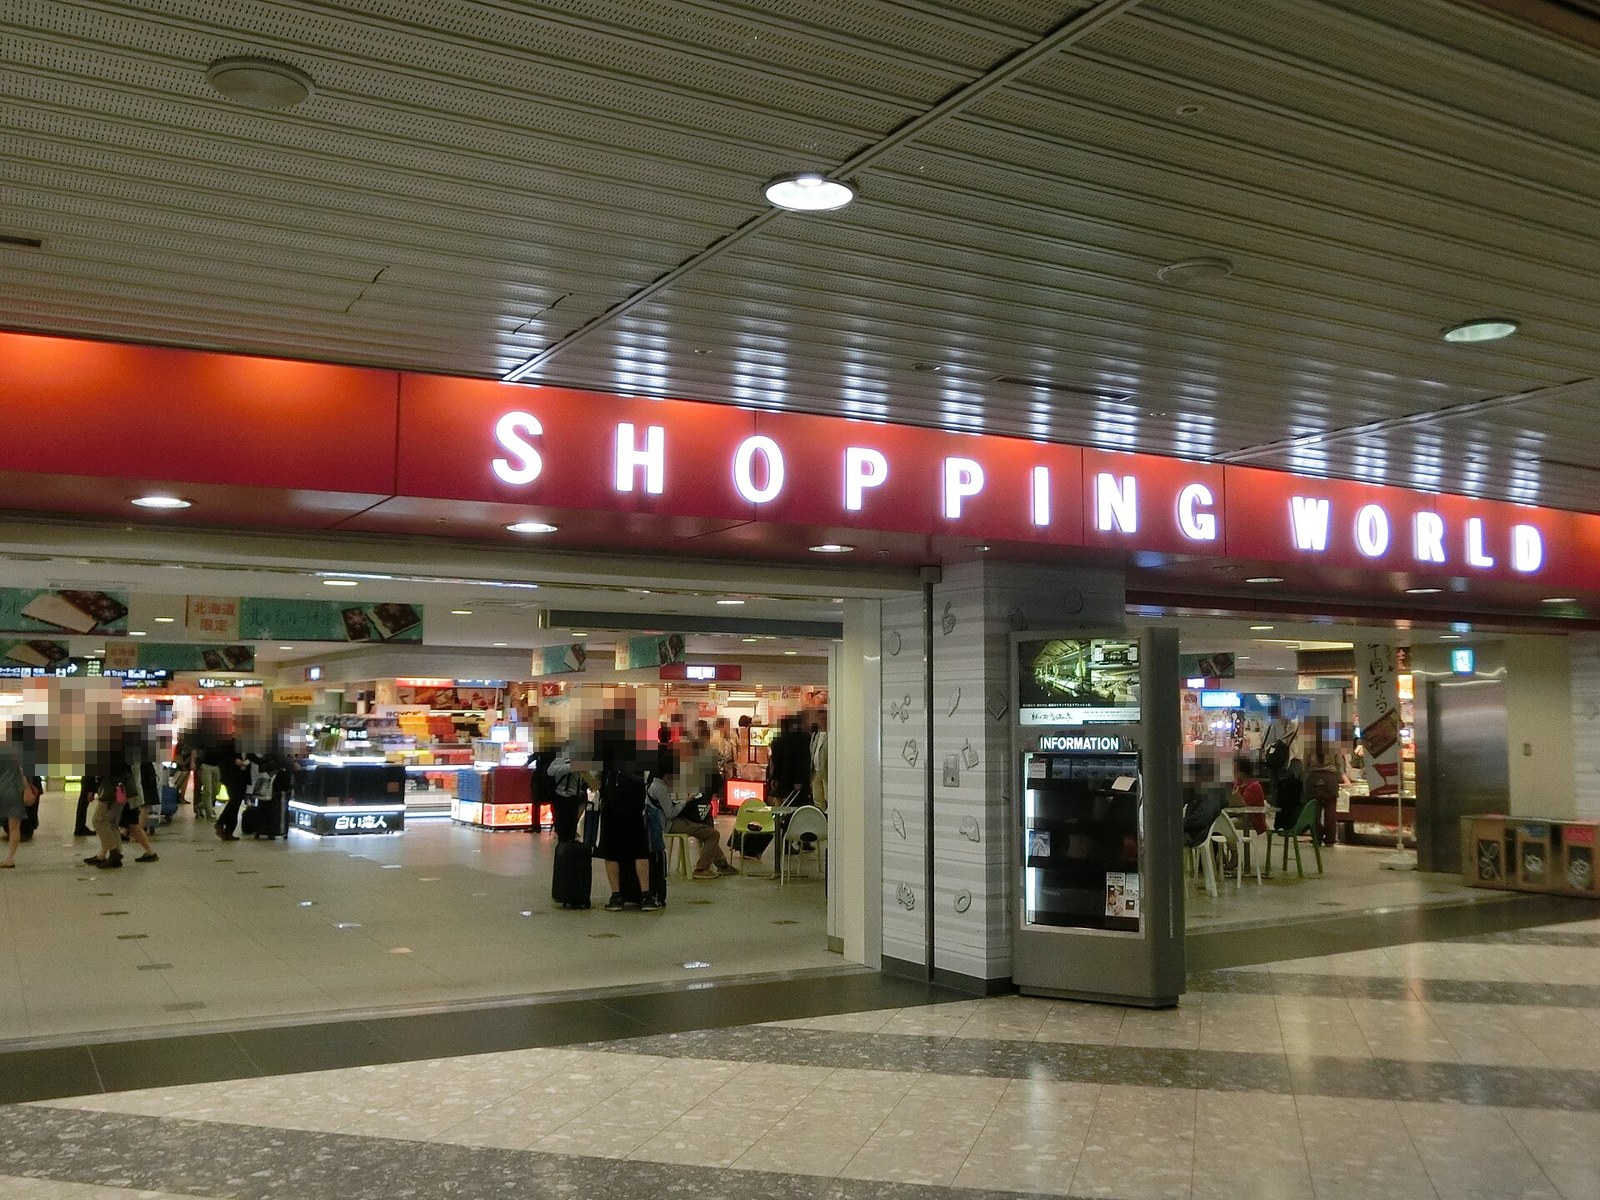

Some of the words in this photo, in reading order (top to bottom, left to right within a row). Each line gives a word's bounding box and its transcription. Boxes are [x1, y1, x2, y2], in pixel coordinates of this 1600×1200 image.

[491, 410, 1217, 541] SHOPPING
[1291, 495, 1544, 573] WORLD
[194, 602, 236, 616] 北海道
[200, 618, 228, 631] 限定
[1040, 737, 1119, 750] INFORMATION
[335, 815, 388, 830] 白い恋人
